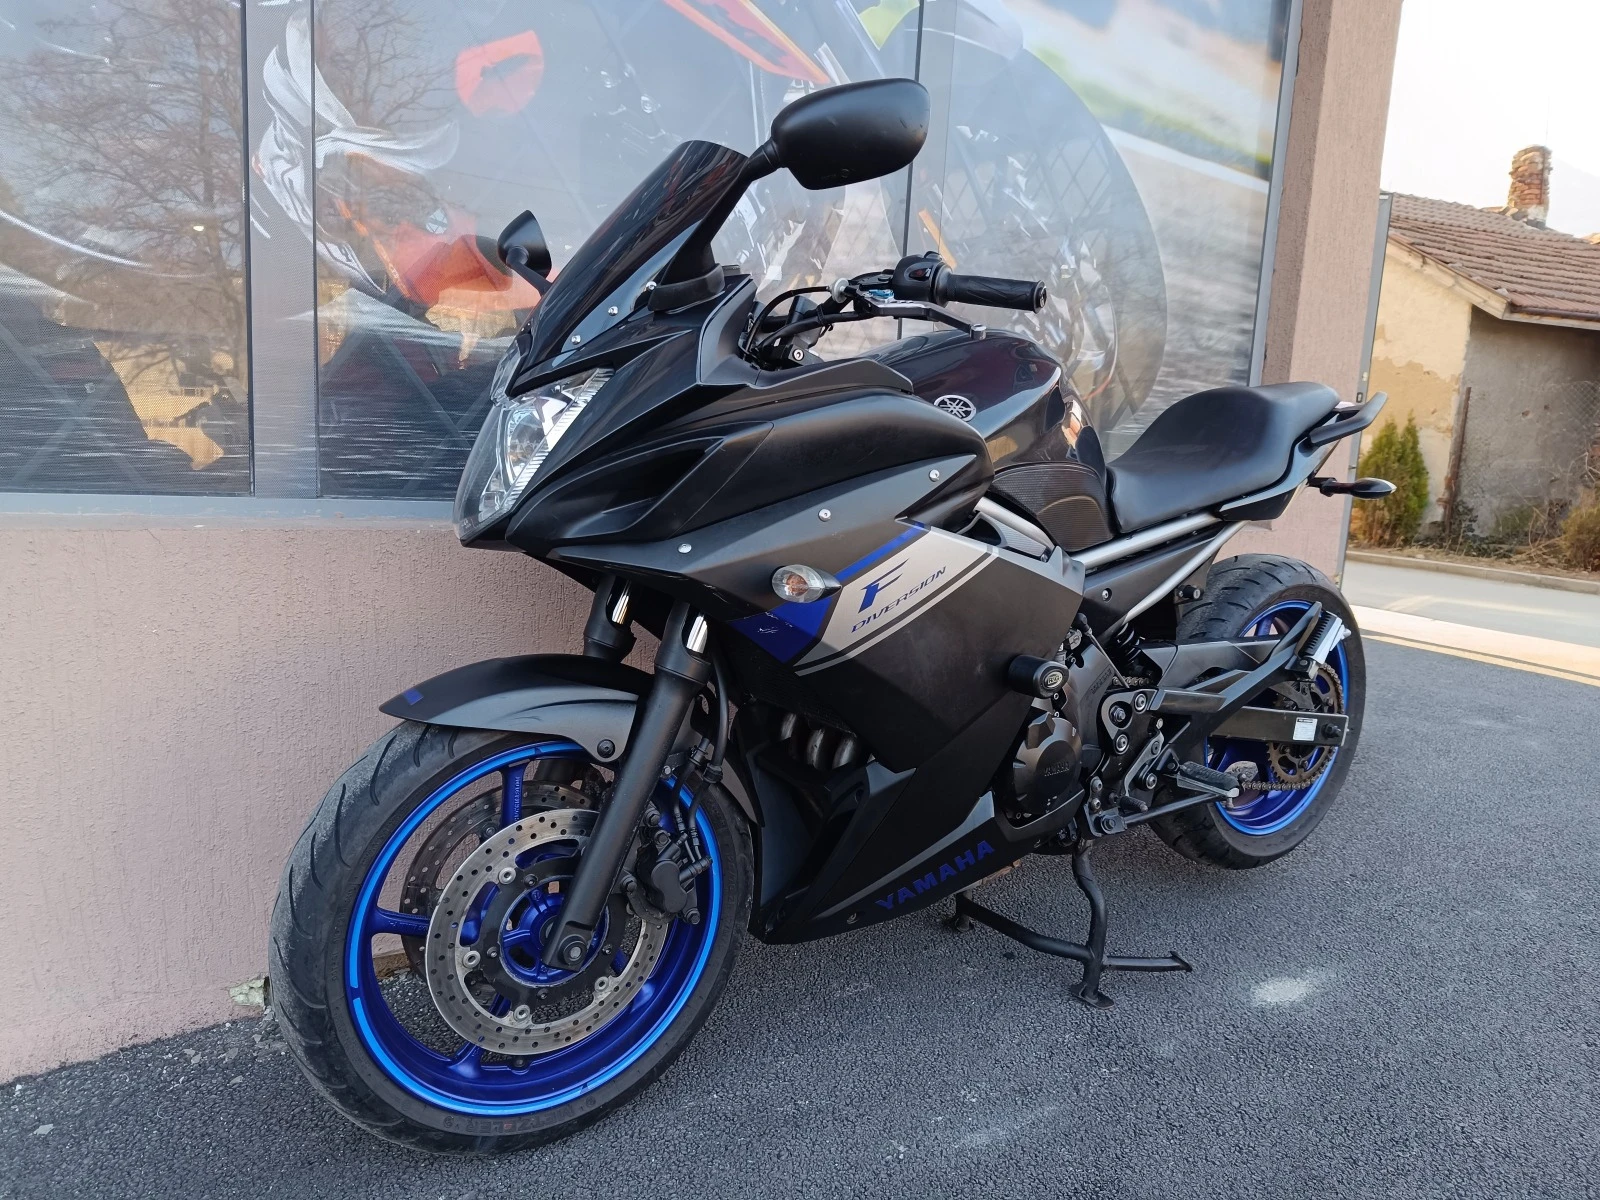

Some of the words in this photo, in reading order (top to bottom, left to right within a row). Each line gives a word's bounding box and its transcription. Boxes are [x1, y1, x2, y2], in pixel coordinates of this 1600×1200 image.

[851, 565, 947, 633] DIVERSION
[858, 557, 909, 614] F
[875, 839, 995, 911] YAMAHA
